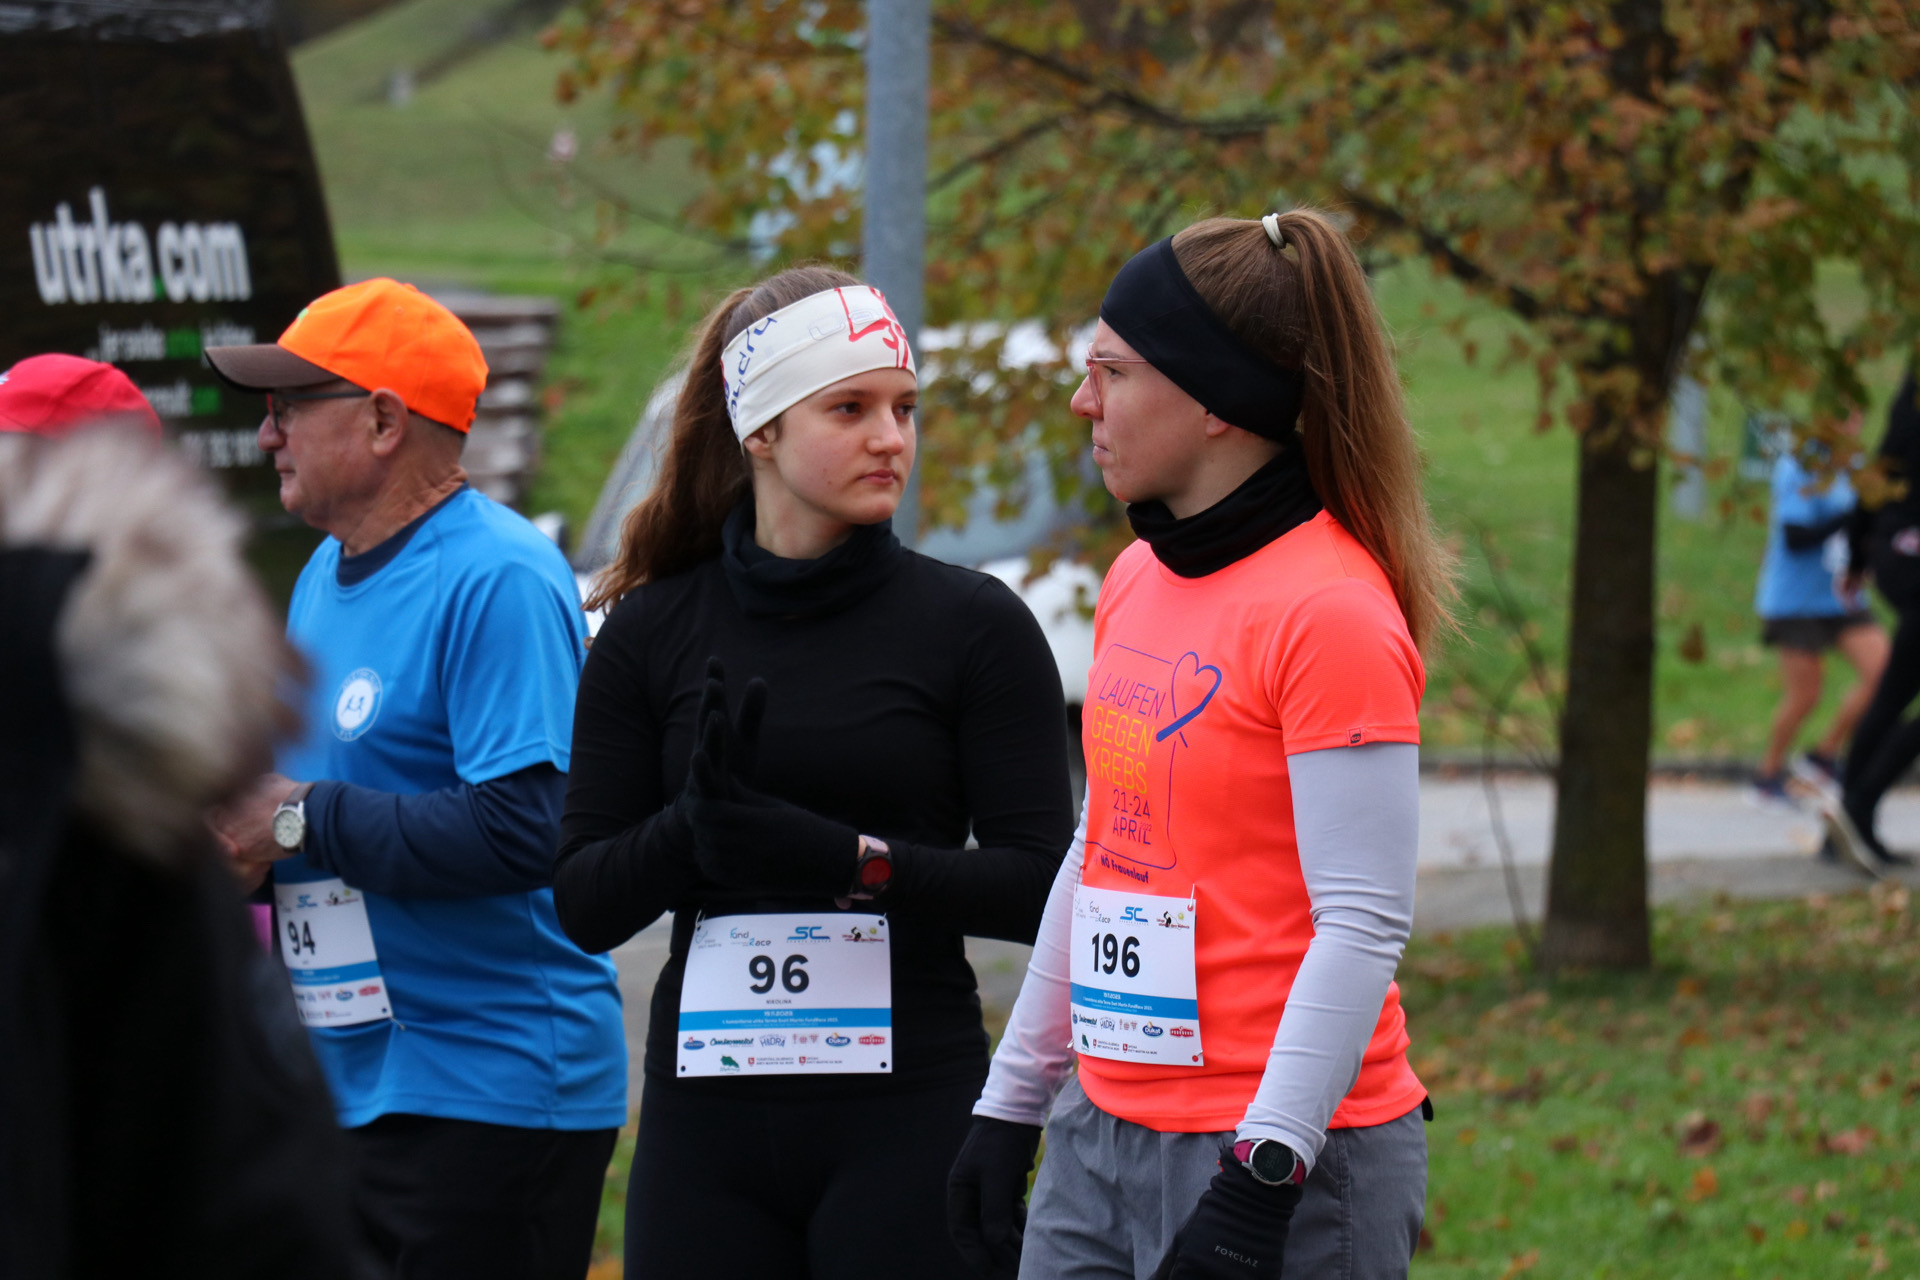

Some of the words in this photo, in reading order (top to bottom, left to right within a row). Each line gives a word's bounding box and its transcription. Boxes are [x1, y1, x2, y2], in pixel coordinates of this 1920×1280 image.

[29, 185, 251, 305] utrka.com
[1098, 672, 1166, 719] LAUFEN
[1091, 705, 1155, 757] GEGEN
[1089, 743, 1148, 794] KREBS
[1113, 788, 1151, 818] 21-24
[1112, 815, 1151, 845] APRIL
[1111, 858, 1149, 884] Frauenlauf
[1120, 906, 1149, 923] SC
[287, 920, 315, 955] 94
[787, 926, 831, 940] SC
[1092, 932, 1140, 978] 196
[749, 954, 810, 994] 96
[1214, 1245, 1258, 1268] FORCLAZ
